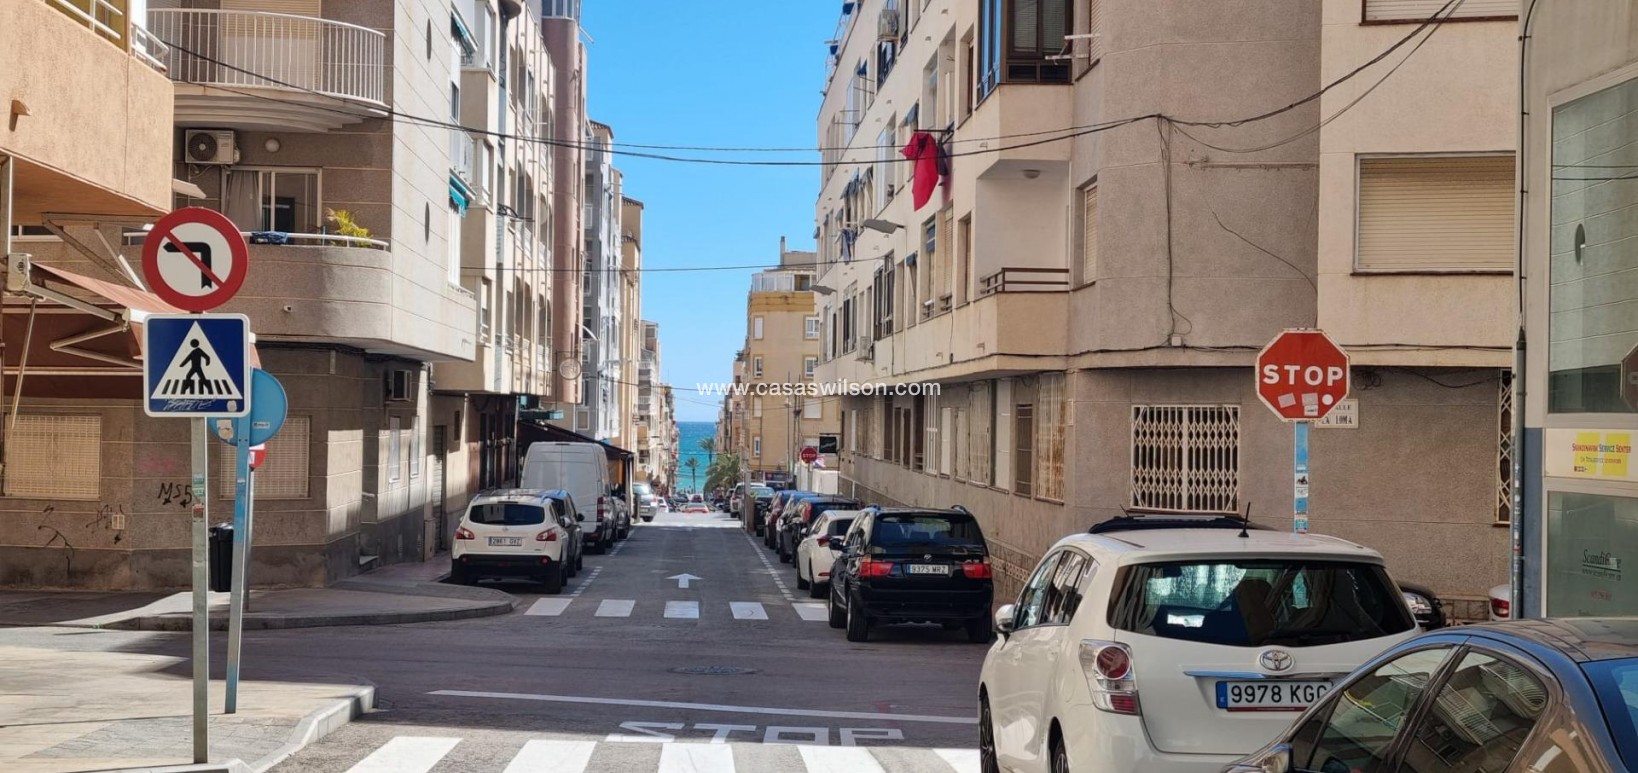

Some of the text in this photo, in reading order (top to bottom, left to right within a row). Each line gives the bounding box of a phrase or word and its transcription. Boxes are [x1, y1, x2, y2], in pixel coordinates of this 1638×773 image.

[1263, 364, 1344, 387] STOP
[1335, 415, 1353, 425] LOMA
[1231, 685, 1282, 703] 9978
[604, 720, 905, 747] STOP
